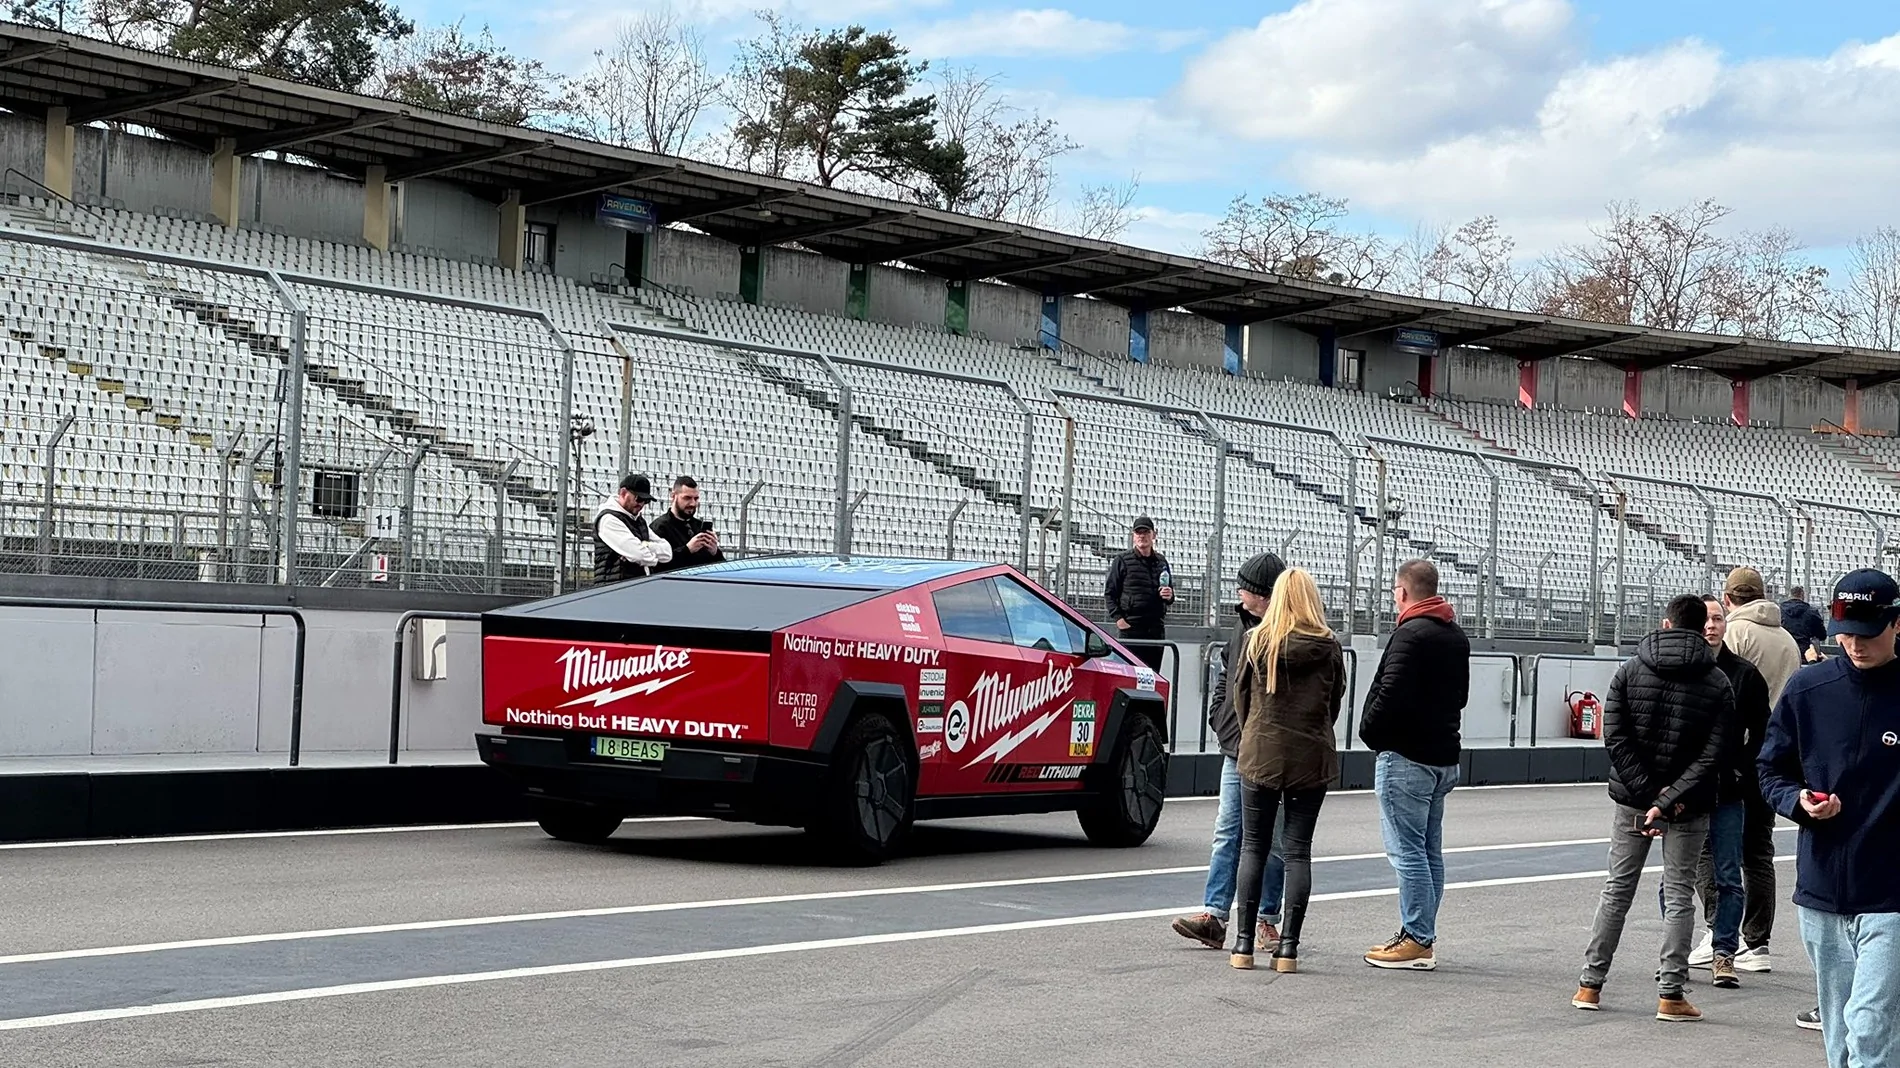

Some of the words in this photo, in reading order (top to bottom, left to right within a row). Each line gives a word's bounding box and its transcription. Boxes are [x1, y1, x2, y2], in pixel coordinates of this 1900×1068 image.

[606, 199, 648, 215] RAVENOL
[784, 633, 831, 659] Nothing
[834, 639, 855, 658] but
[857, 641, 901, 662] HEAVY
[903, 647, 940, 666] DUTY.
[555, 645, 691, 693] Milwaukee
[778, 691, 818, 707] ELEKTRO
[967, 659, 1074, 744] Milwaukee
[791, 706, 816, 721] AUTO
[1072, 703, 1095, 719] DEKRA
[506, 708, 573, 729] Nothing
[578, 712, 607, 729] but
[612, 715, 680, 735] HEAVY
[1077, 722, 1090, 742] 30
[621, 740, 669, 759] BEAST
[1073, 743, 1089, 755] ADAC
